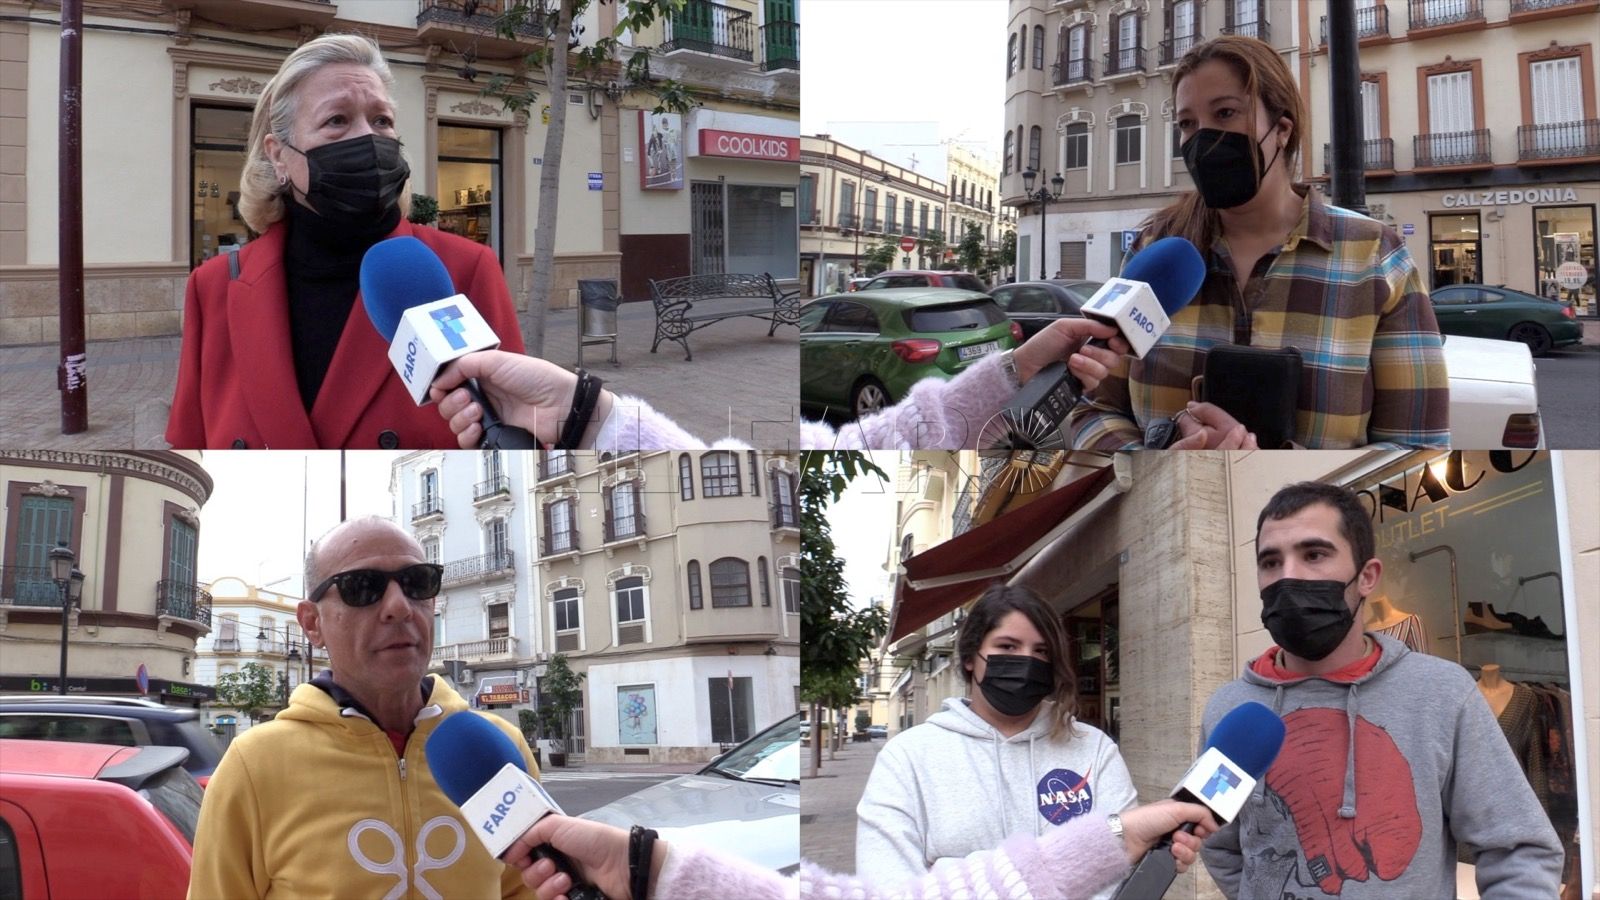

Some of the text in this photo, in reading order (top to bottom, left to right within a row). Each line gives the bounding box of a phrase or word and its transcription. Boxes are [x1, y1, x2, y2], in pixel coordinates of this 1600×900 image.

[718, 135, 788, 158] COOLKIDS
[1442, 187, 1577, 207] CALZEDONIA
[1125, 232, 1134, 249] P
[1129, 306, 1154, 333] FARO
[403, 341, 417, 384] FARO
[489, 691, 518, 700] TABACOS
[1040, 788, 1090, 806] NASA
[482, 791, 516, 835] FARO
